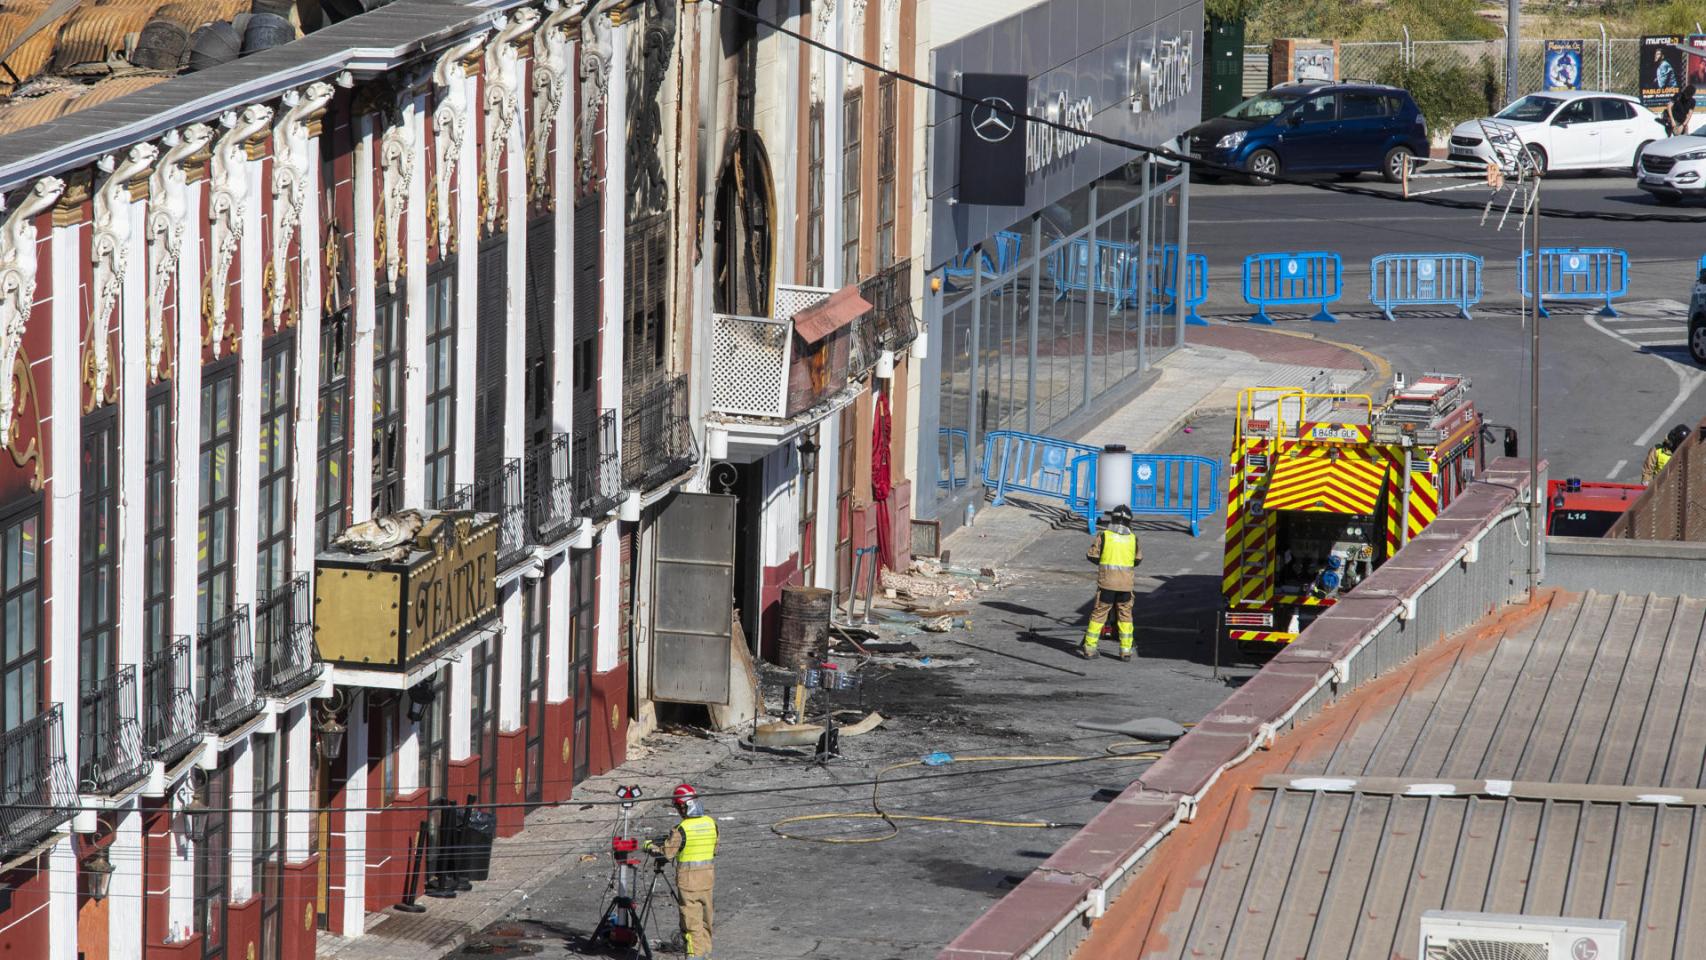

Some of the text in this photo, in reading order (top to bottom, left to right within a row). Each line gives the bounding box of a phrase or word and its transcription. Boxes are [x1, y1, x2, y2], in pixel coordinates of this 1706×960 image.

[1149, 30, 1193, 112] Certified
[1025, 106, 1053, 175] Auto
[1567, 512, 1587, 521] L14
[415, 552, 488, 644] TEATRE
